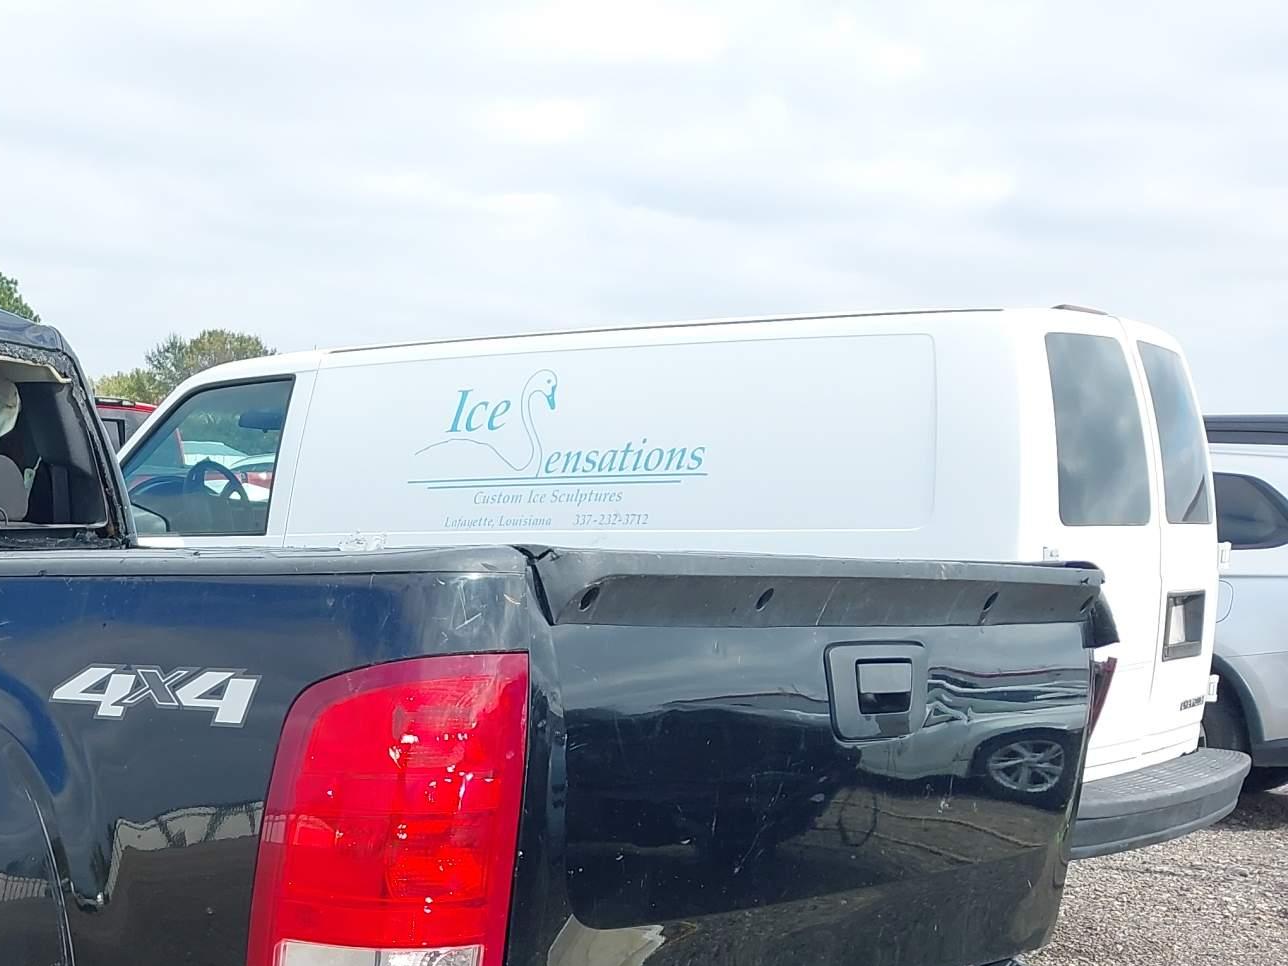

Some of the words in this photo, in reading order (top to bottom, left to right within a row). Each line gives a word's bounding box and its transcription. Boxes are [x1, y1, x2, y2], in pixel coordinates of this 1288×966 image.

[445, 388, 511, 434] Ice
[473, 490, 522, 506] Custom
[527, 489, 546, 504] Ice
[550, 487, 623, 507] Sculptures
[443, 516, 496, 528] Lafayette,
[499, 514, 552, 527] Louisiana
[574, 513, 649, 526] 337-232-3712
